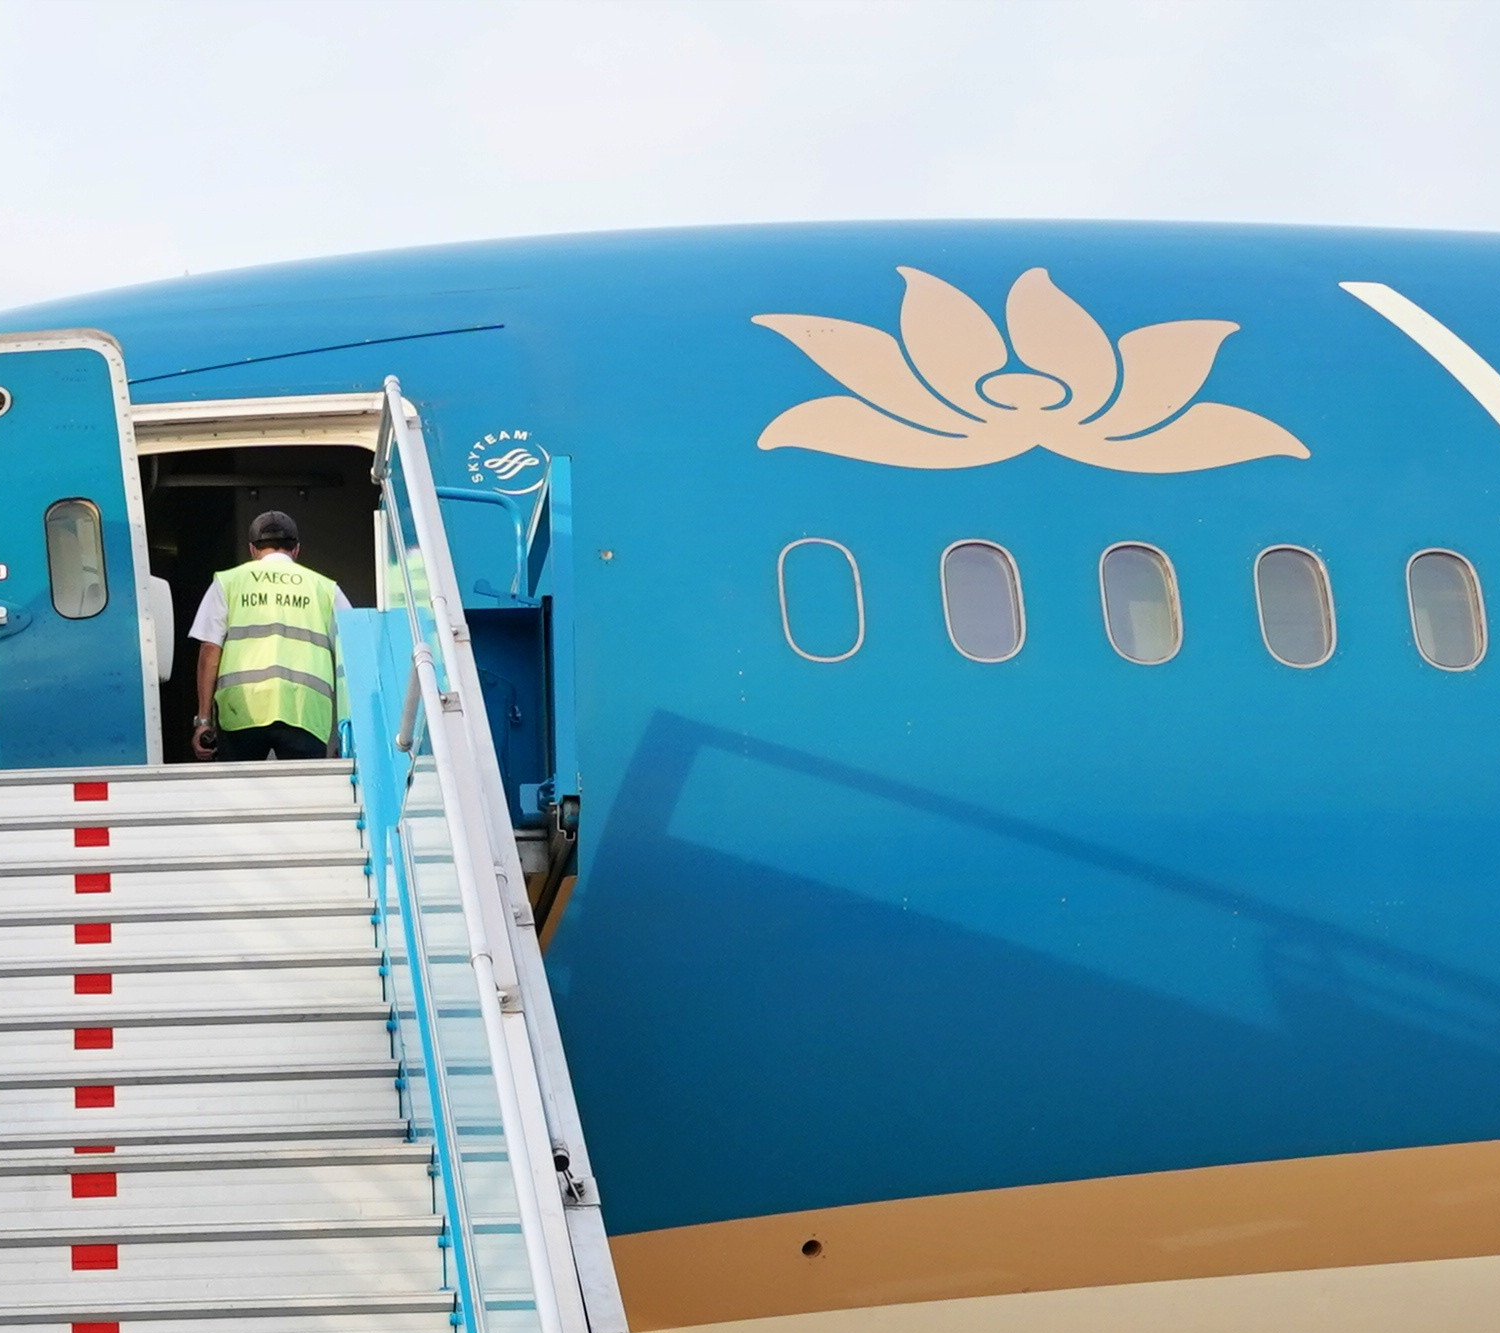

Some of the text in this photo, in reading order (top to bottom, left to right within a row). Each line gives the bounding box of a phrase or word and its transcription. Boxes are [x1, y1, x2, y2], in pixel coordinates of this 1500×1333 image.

[467, 430, 528, 483] SKYTEAM
[251, 571, 303, 586] VAECO
[241, 593, 310, 609] HCM RAMP
